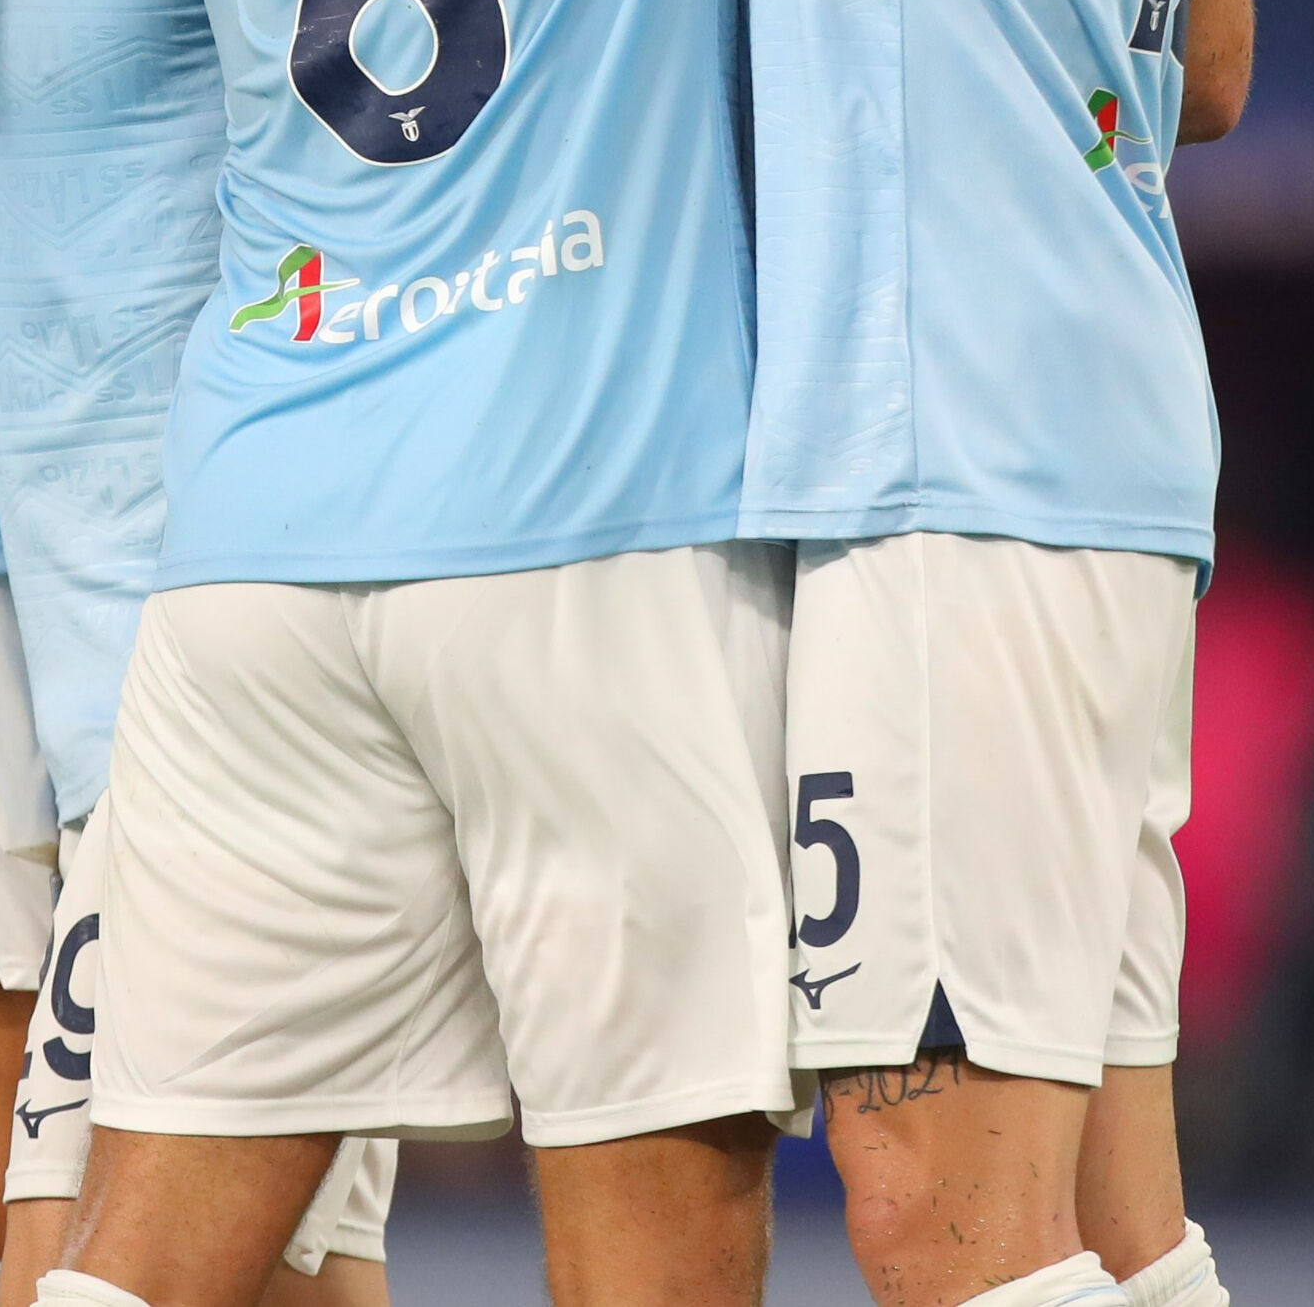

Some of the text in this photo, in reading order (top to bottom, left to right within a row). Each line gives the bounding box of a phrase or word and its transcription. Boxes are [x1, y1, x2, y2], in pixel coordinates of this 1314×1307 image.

[229, 208, 606, 346] Aeroitaia
[788, 770, 860, 949] 5
[19, 912, 100, 1081] 9
